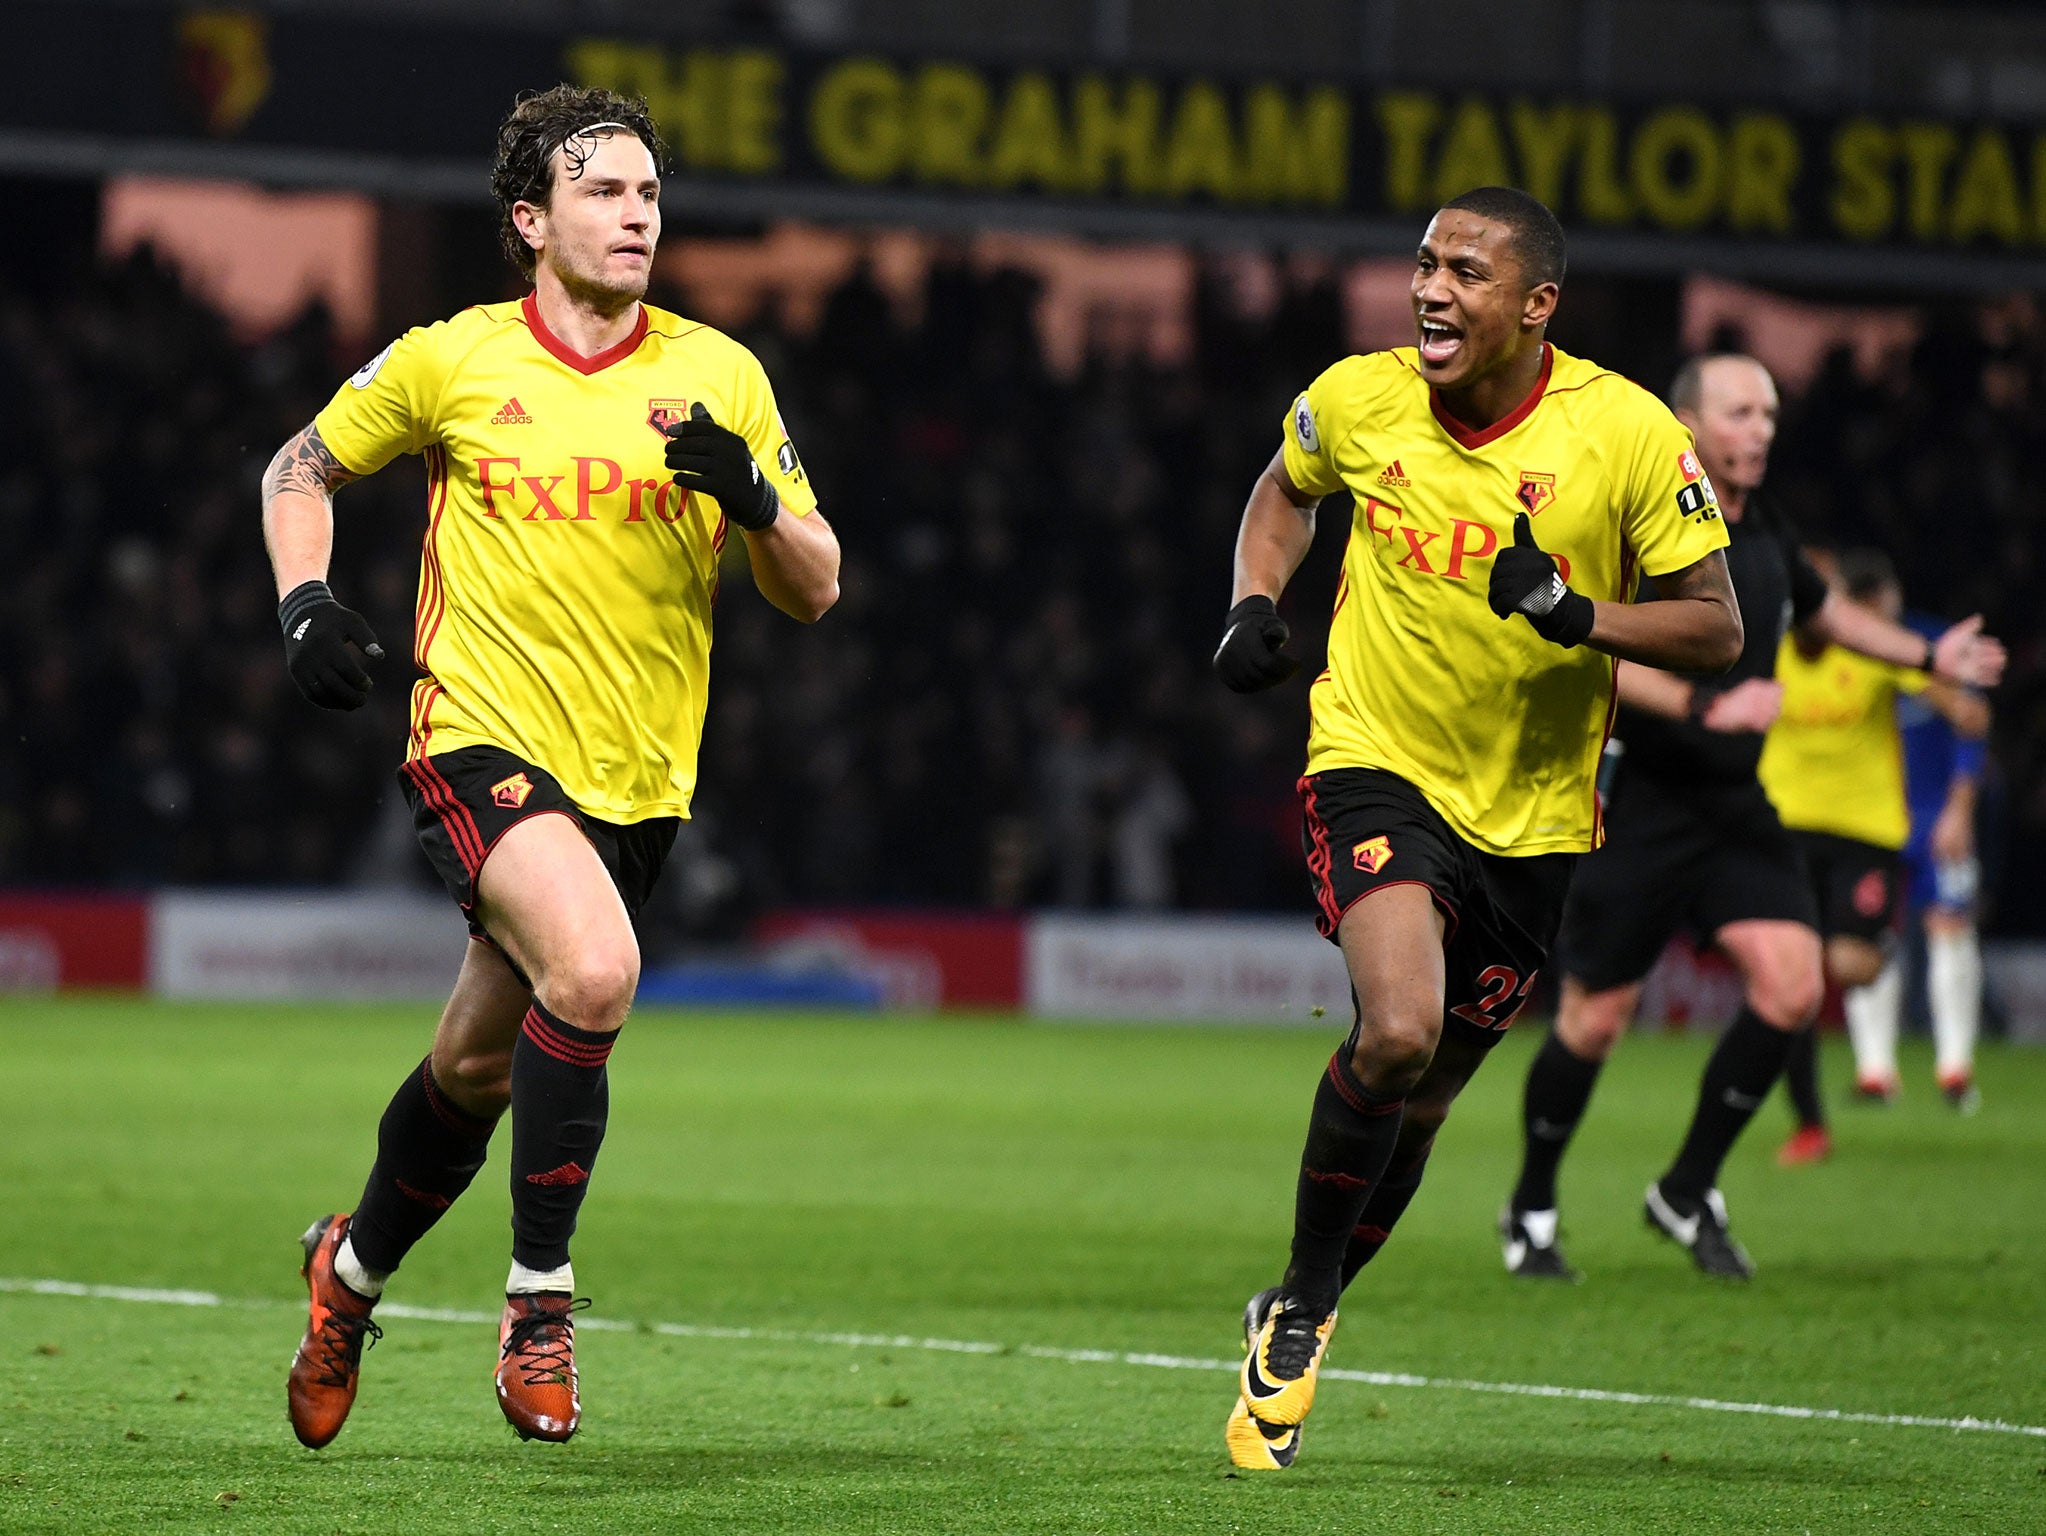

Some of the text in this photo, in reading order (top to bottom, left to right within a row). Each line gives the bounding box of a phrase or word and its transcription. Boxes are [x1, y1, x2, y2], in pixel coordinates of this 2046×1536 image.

[570, 42, 2046, 240] THE GRAHAM TAYLOR STA
[490, 414, 533, 425] adidas
[473, 456, 690, 524] FxPro
[1376, 474, 1412, 488] adidas
[1366, 496, 1571, 586] FxPo
